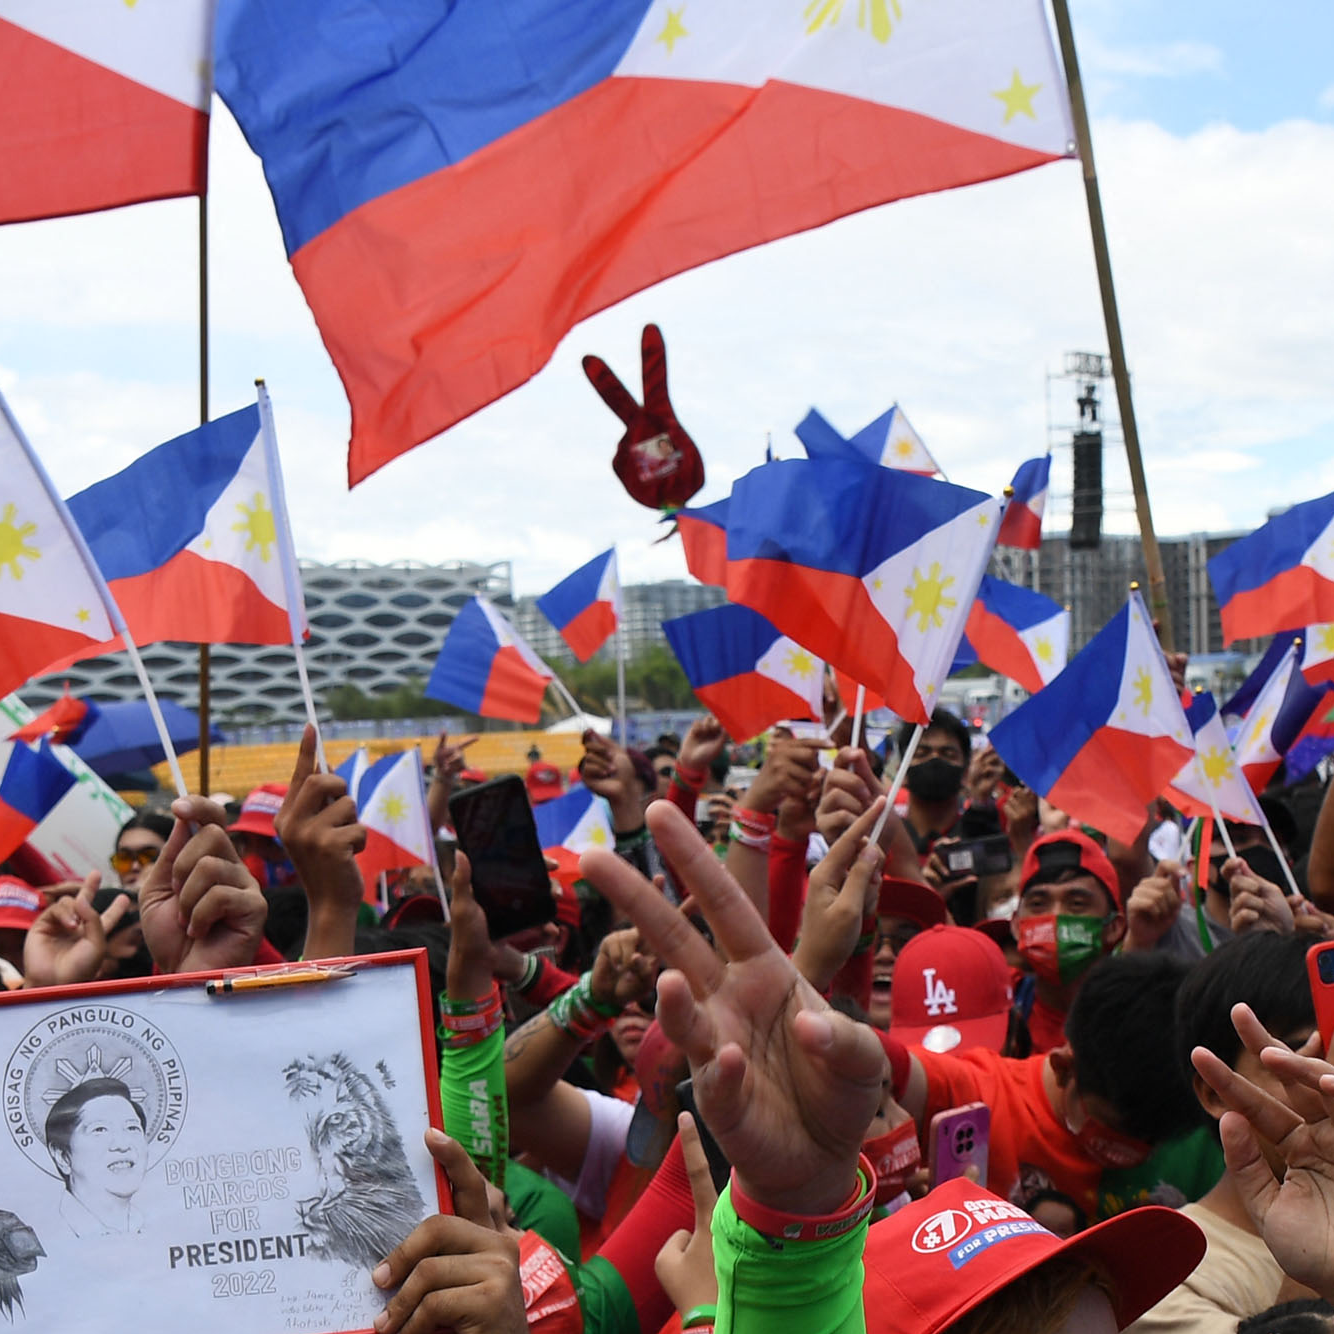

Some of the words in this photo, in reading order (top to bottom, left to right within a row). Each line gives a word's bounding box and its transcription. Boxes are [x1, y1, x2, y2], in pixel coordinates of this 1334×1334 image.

[922, 968, 958, 1016] LA
[48, 1009, 135, 1034] PANGULO
[20, 1035, 42, 1059] NG
[141, 1028, 165, 1051] NG
[7, 1068, 34, 1147] SAGISAG
[157, 1058, 183, 1144] PILIPINAS
[165, 1147, 302, 1186] BONGBONG
[183, 1177, 290, 1209] MARCOS
[210, 1206, 260, 1234] FOR
[922, 1209, 957, 1249] #7
[169, 1234, 309, 1269] PRESIDENT
[957, 1239, 982, 1259] FOR
[211, 1269, 277, 1298] 2022
